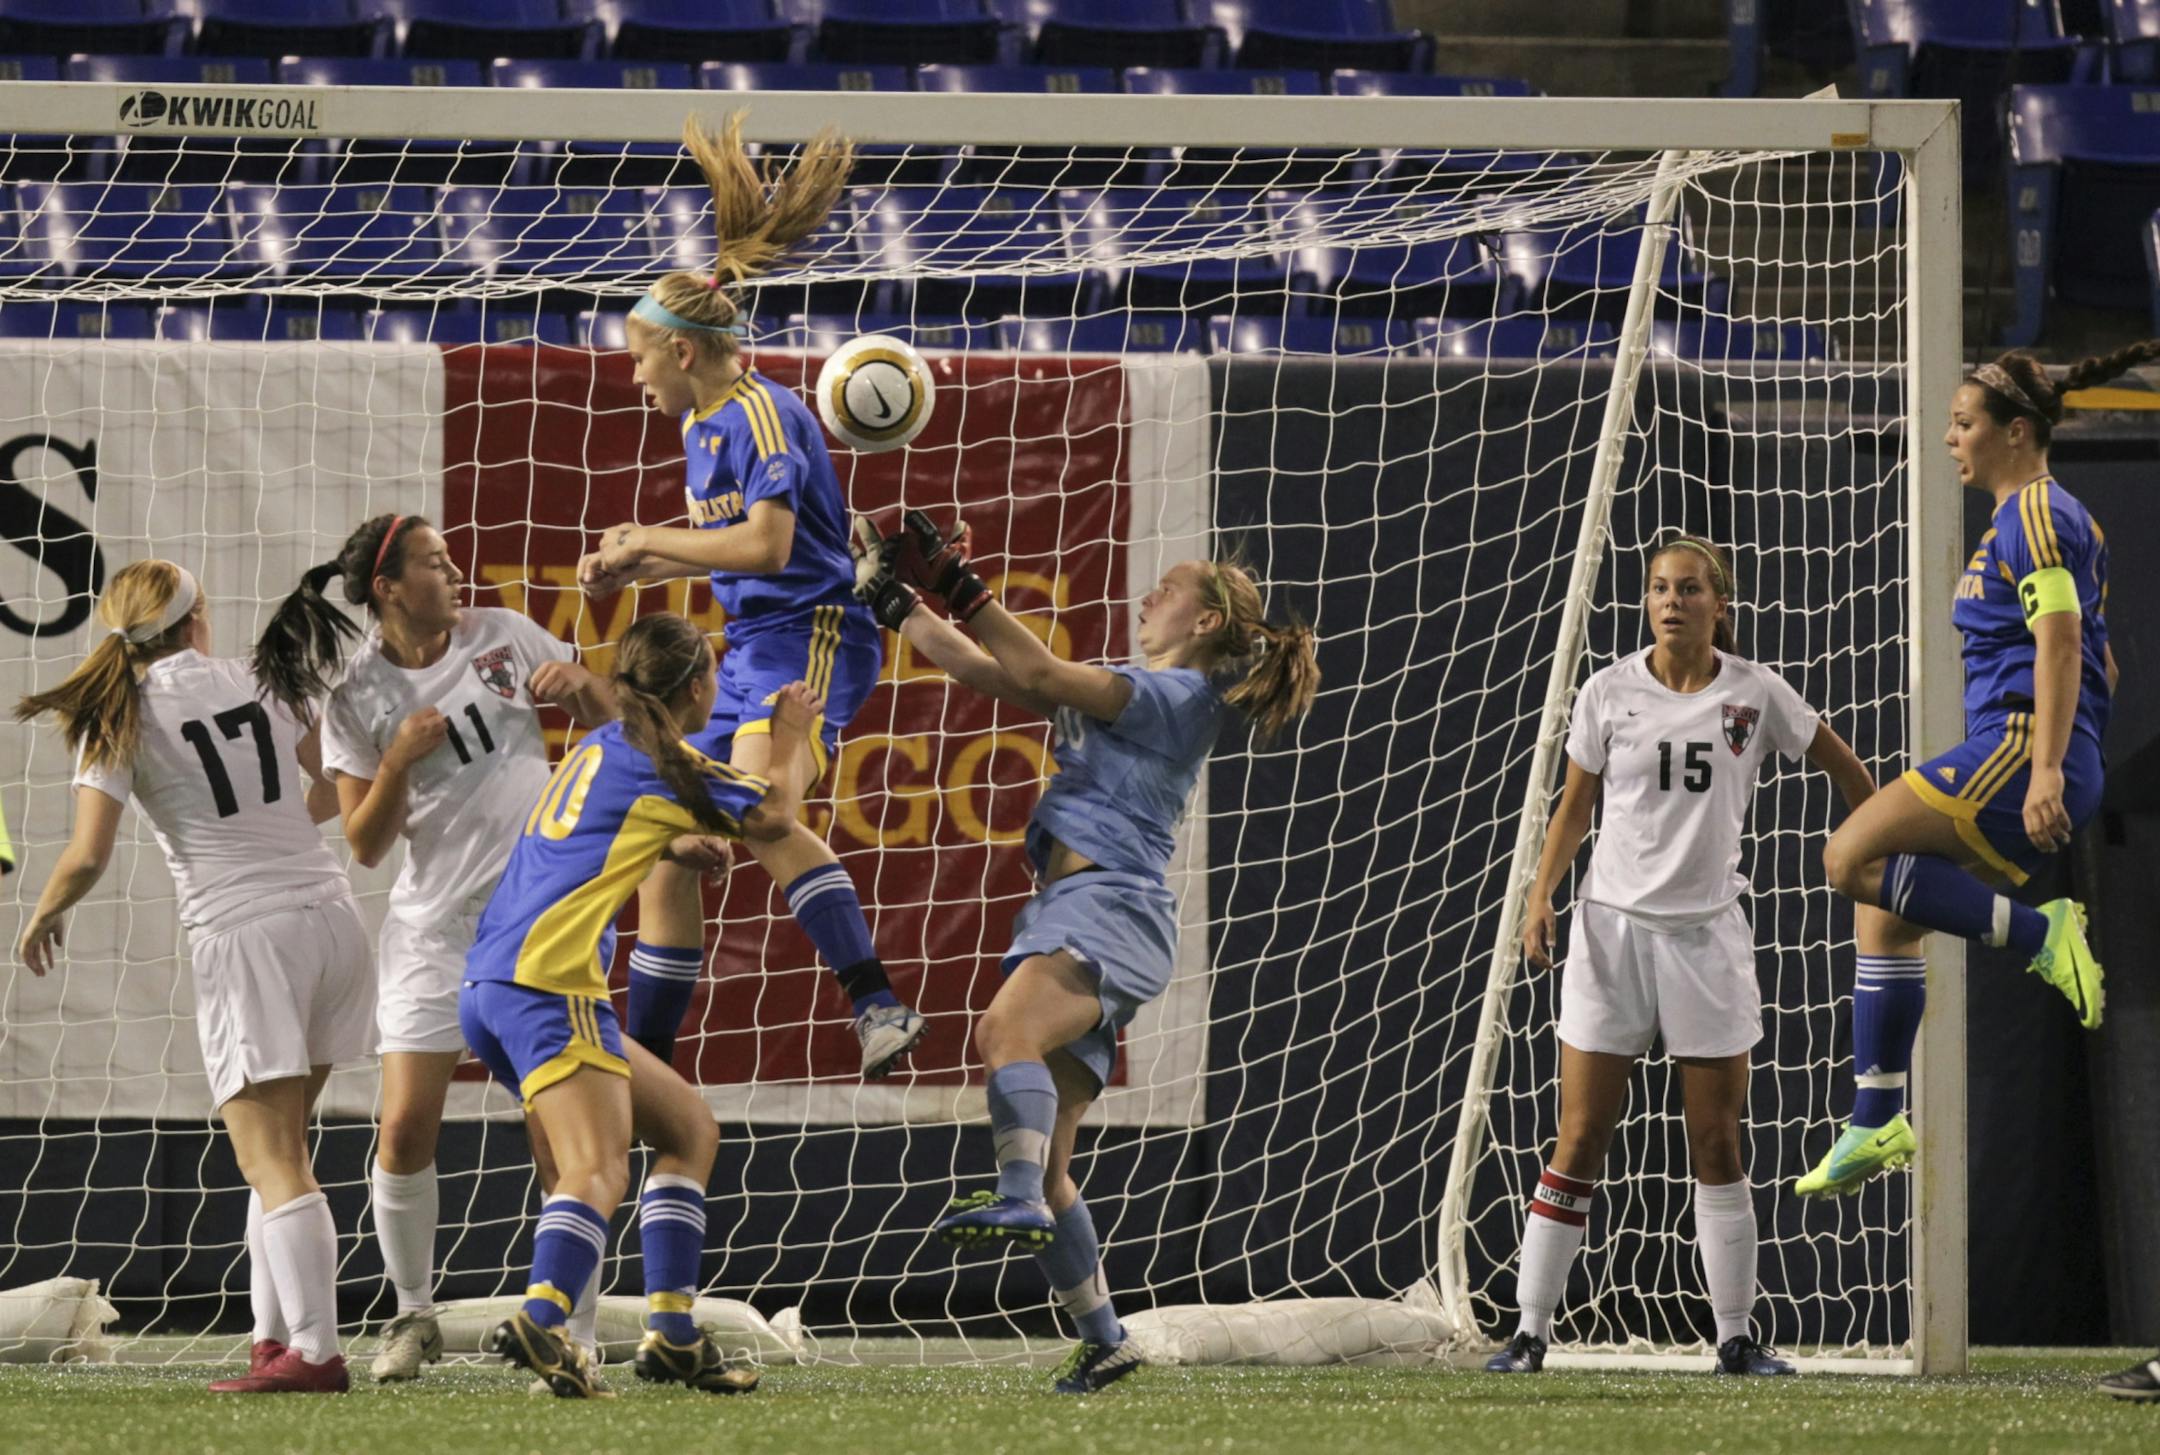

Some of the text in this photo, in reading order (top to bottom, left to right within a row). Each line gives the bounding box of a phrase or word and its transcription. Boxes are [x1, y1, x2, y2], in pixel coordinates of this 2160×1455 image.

[168, 95, 319, 130] KWIKGOAL
[2021, 582, 2039, 620] C
[181, 700, 281, 818] 17
[444, 701, 495, 765] 11
[525, 744, 604, 840] 10
[1658, 741, 1713, 793] 15
[1539, 1185, 1577, 1208] CAPTAIN
